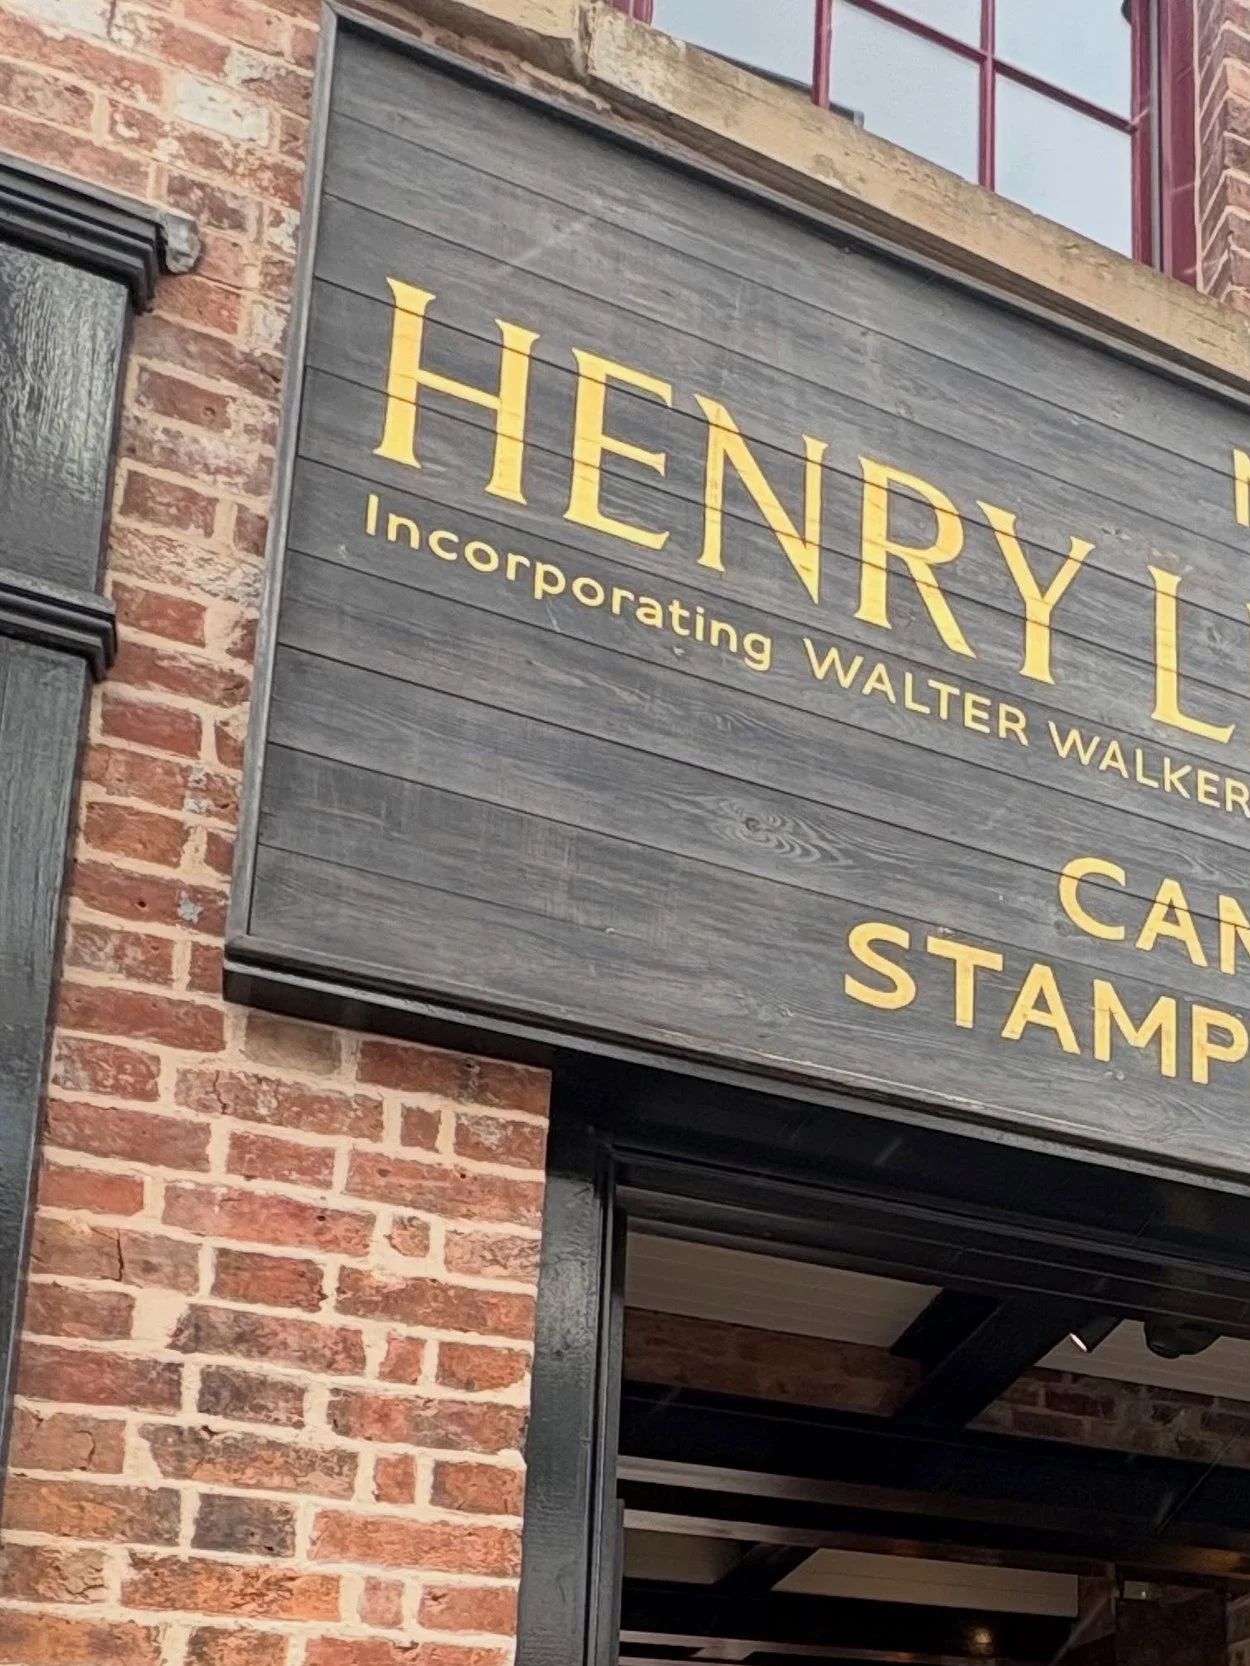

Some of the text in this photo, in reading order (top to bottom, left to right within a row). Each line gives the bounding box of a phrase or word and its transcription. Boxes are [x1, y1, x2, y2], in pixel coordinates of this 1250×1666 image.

[363, 493, 773, 672] Incorporating
[803, 637, 1029, 746] WALTER
[373, 276, 1096, 686] HENRY
